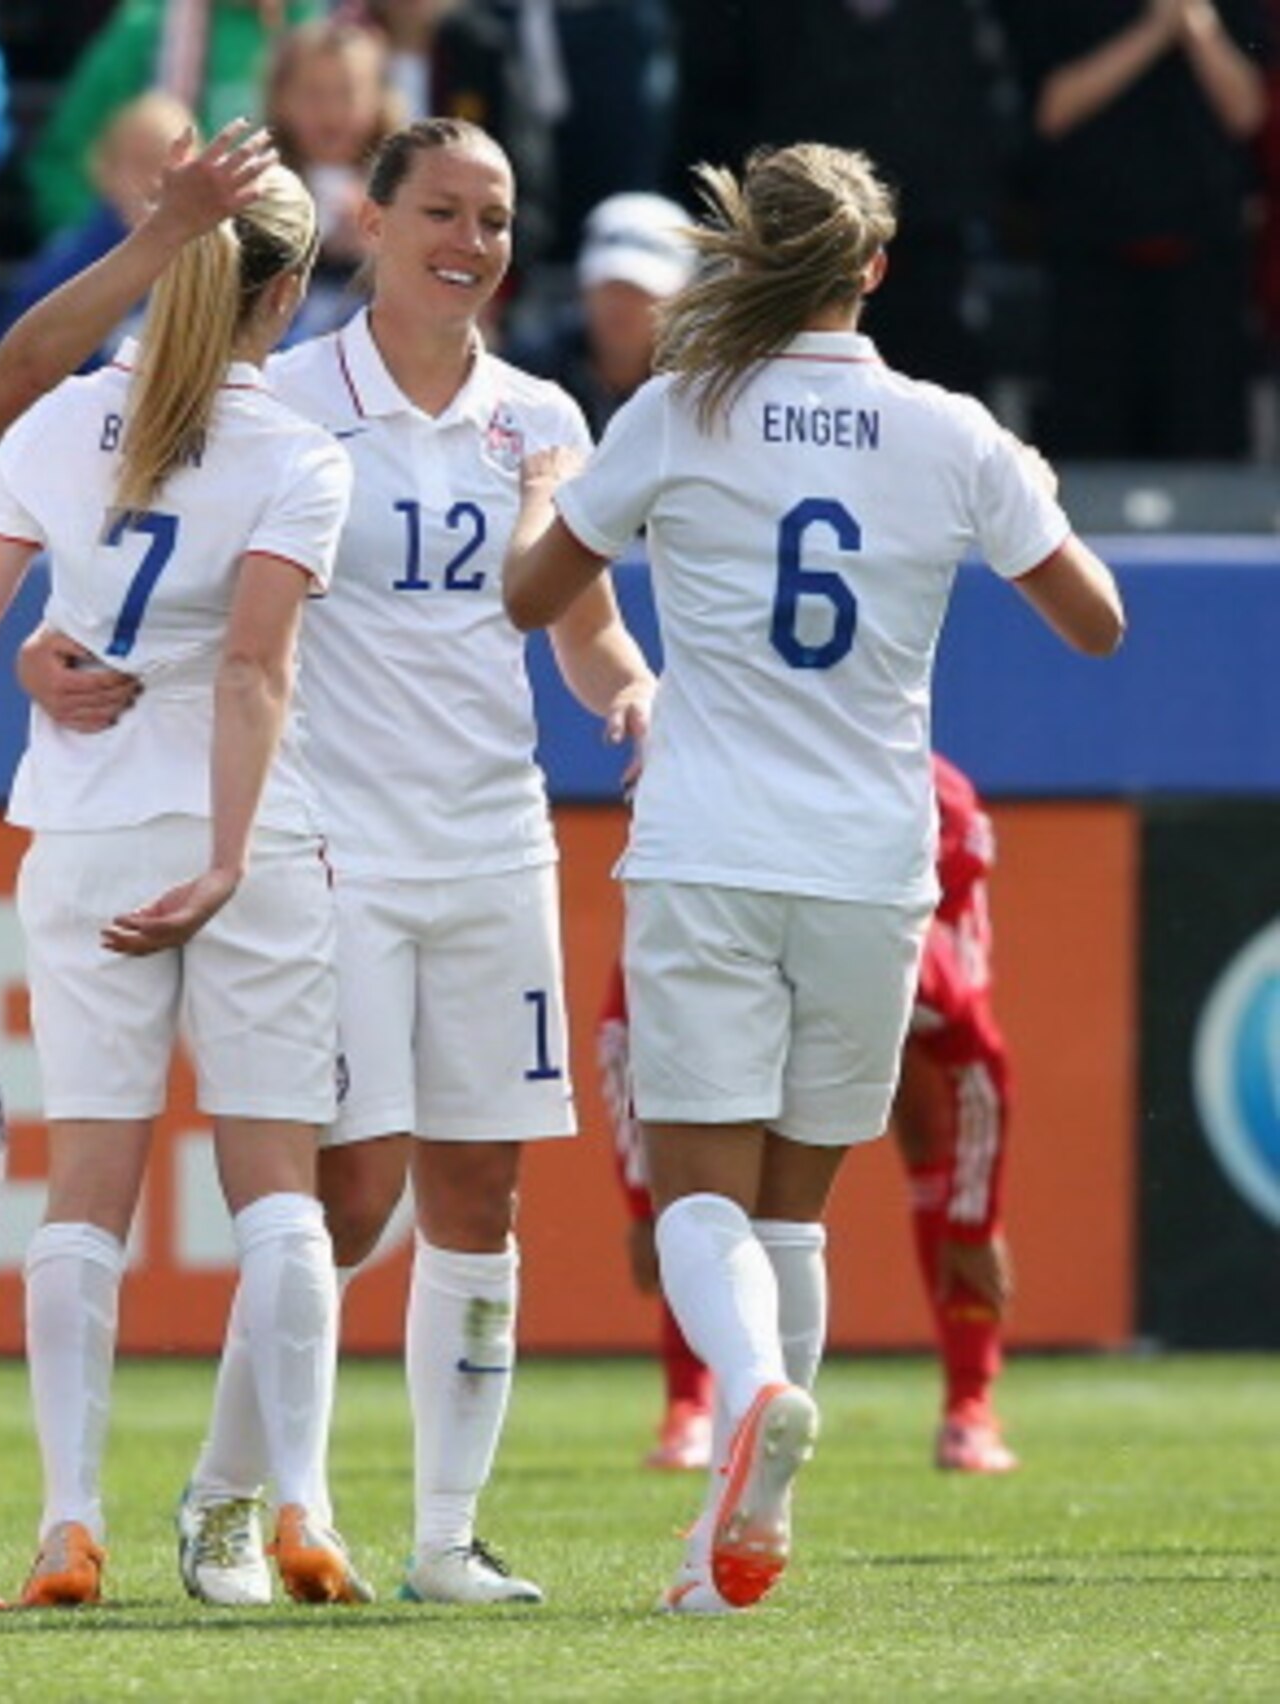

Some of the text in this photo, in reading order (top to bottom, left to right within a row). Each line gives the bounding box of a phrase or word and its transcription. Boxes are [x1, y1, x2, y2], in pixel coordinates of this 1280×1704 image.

[763, 404, 880, 449] ENGEN
[100, 508, 180, 659] 7
[393, 500, 487, 591] 12
[769, 497, 862, 669] 6
